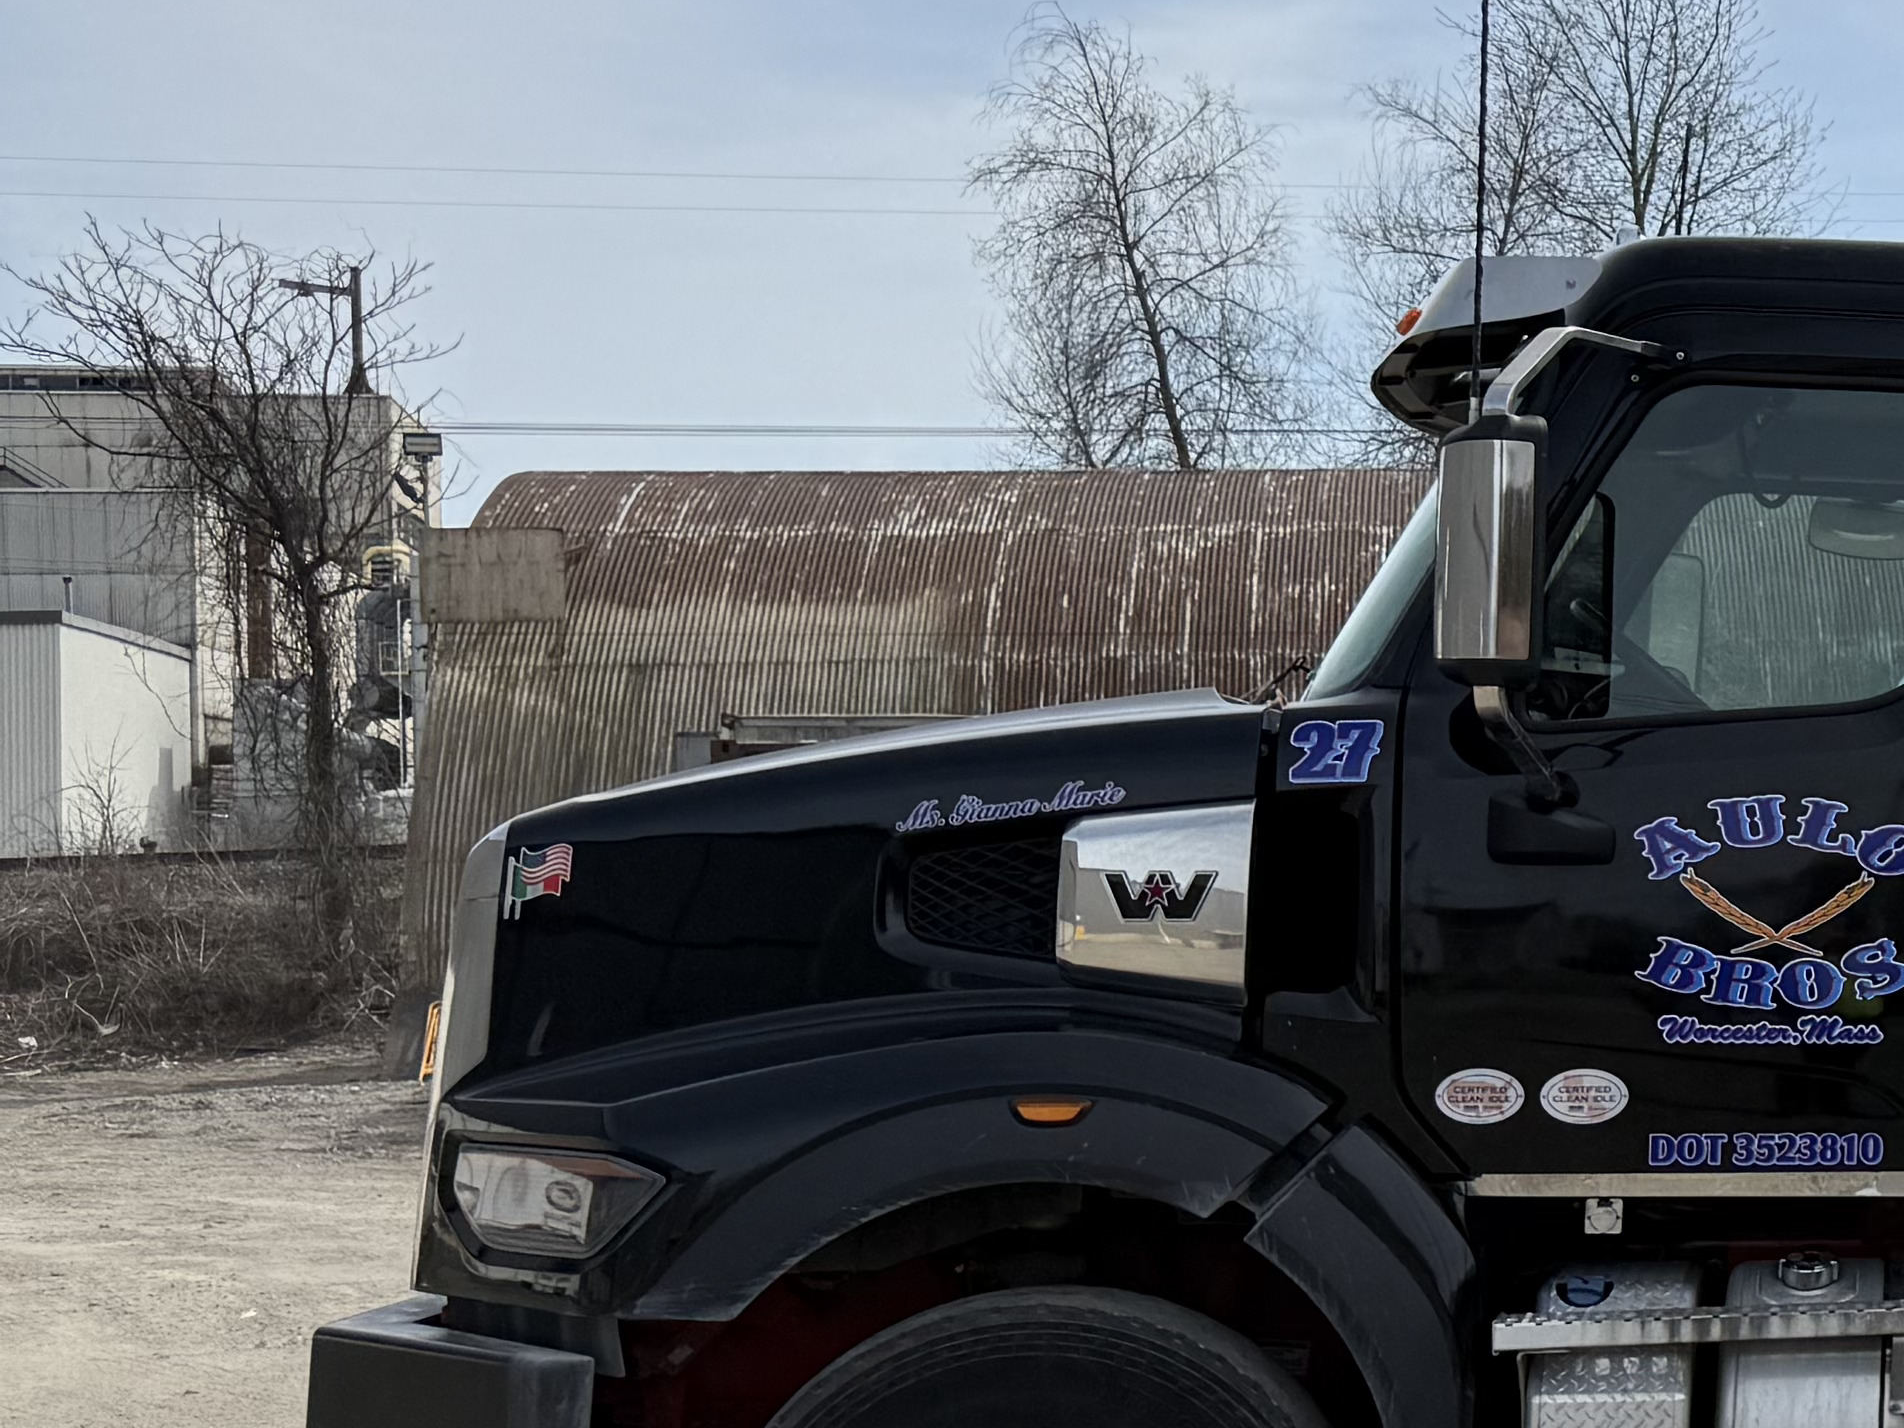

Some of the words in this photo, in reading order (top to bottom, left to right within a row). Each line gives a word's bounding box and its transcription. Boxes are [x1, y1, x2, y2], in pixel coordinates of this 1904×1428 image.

[1289, 720, 1385, 784] 27
[895, 799, 946, 832] Ms.
[949, 794, 1041, 826] Gianna
[1041, 780, 1127, 813] Marie
[1658, 1014, 1802, 1046] Worcester,
[1798, 1014, 1884, 1045] Mass
[1448, 1095, 1486, 1104] CLEAN
[1552, 1094, 1589, 1103] CLEAN
[1592, 1094, 1617, 1103] IDLE
[1558, 1085, 1612, 1094] CERTIFIED
[1648, 1132, 1729, 1167] DOT
[1732, 1132, 1884, 1167] 3523810
